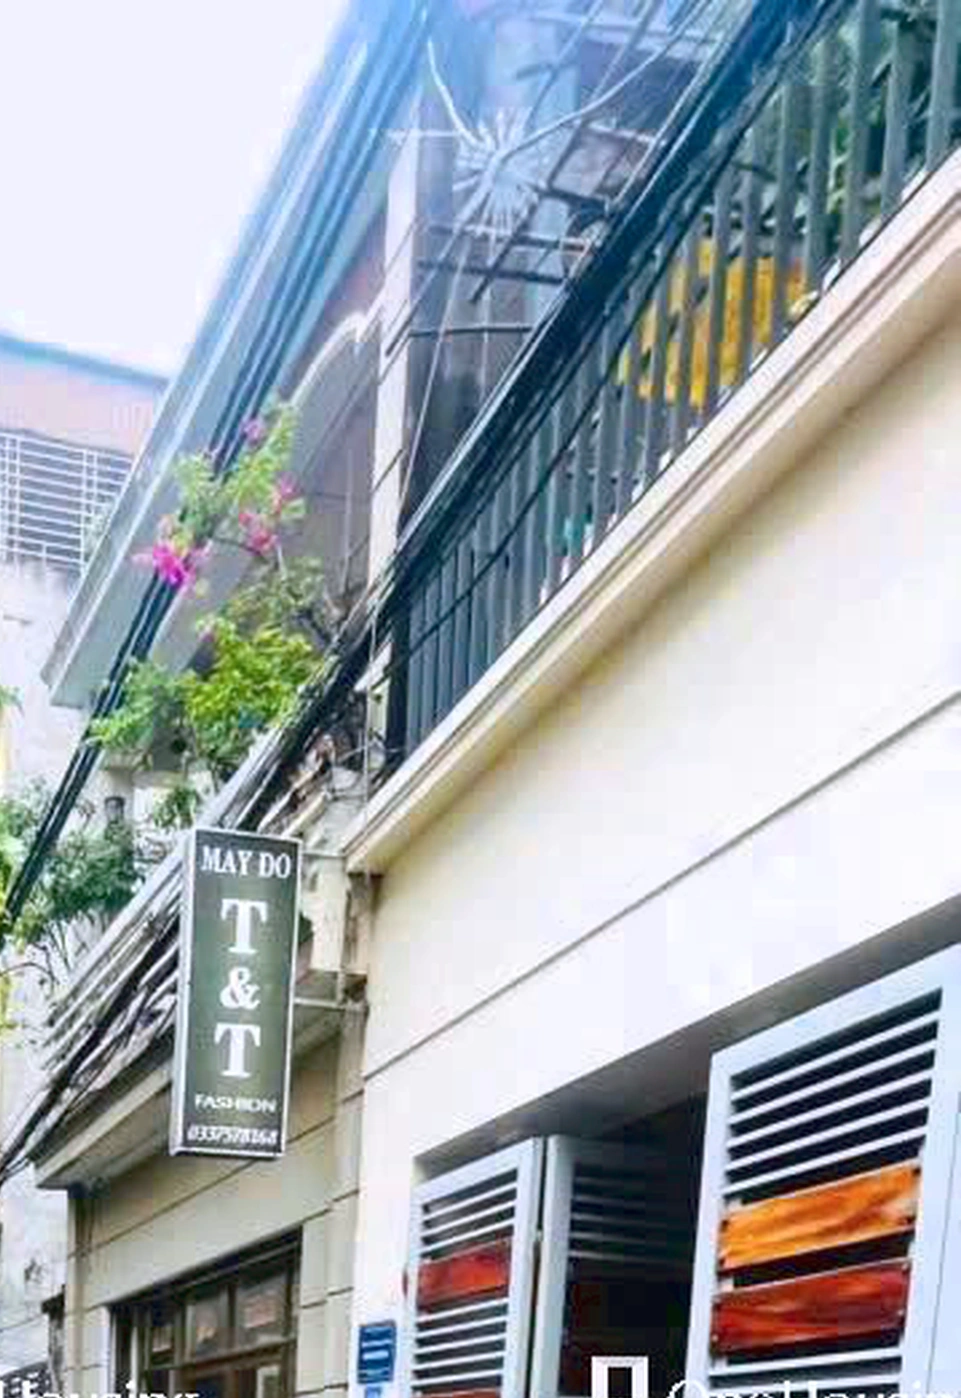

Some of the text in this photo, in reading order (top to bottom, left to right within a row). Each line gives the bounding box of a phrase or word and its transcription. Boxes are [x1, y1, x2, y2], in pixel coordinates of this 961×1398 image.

[201, 845, 291, 879] MAY DO
[214, 898, 268, 1078] T & T
[195, 1093, 277, 1113] FASHION
